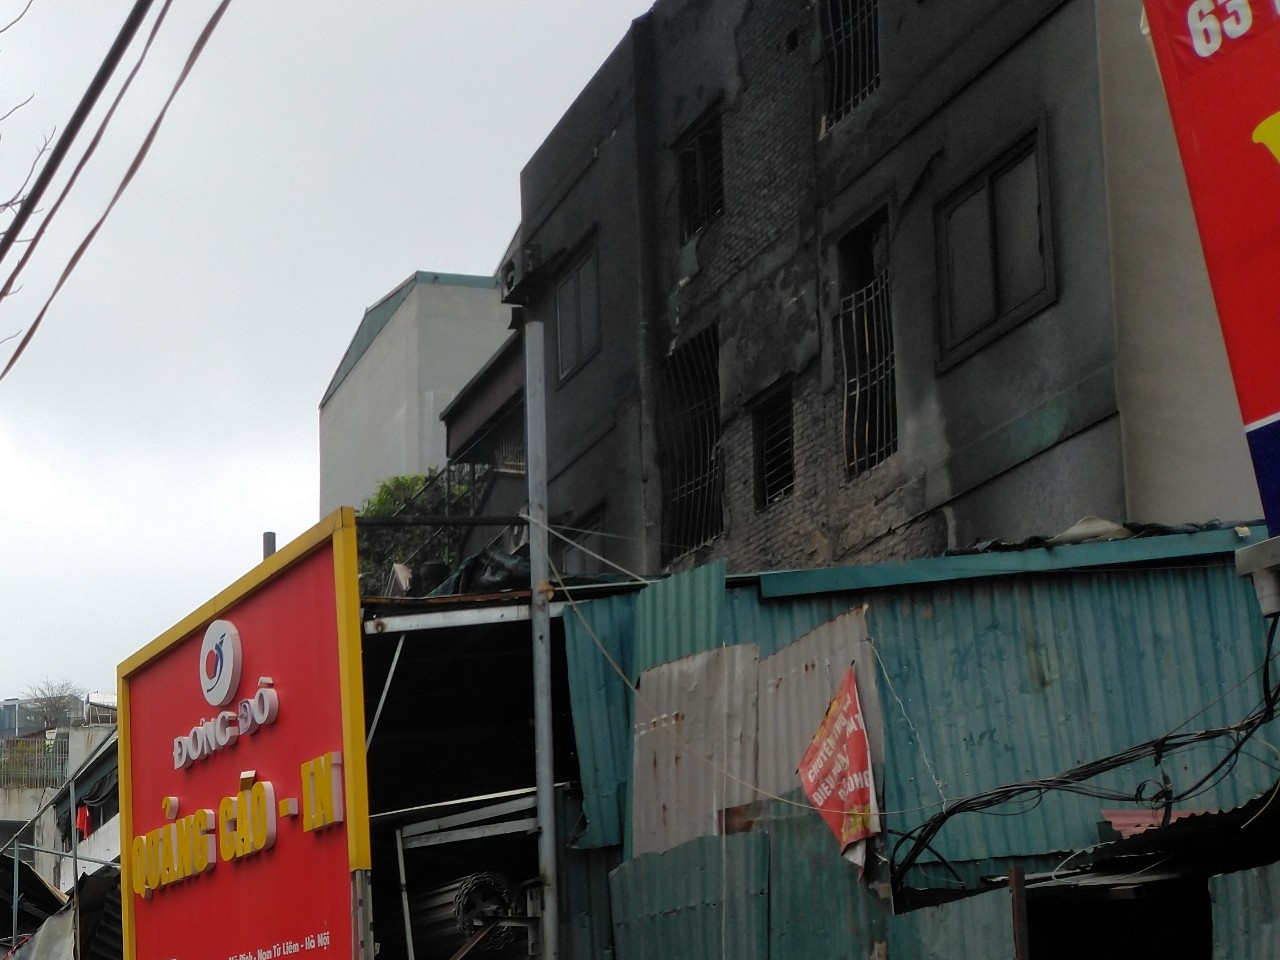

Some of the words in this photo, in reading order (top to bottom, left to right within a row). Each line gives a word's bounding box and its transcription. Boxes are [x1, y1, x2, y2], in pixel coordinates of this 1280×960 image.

[1187, 0, 1253, 58] 63
[132, 796, 217, 899] QUẢNG
[219, 770, 277, 862] CÁO
[301, 751, 344, 833] IN
[272, 945, 282, 958] Từ
[282, 940, 299, 955] Liêm
[305, 935, 316, 950] Hà
[317, 931, 330, 951] Nội
